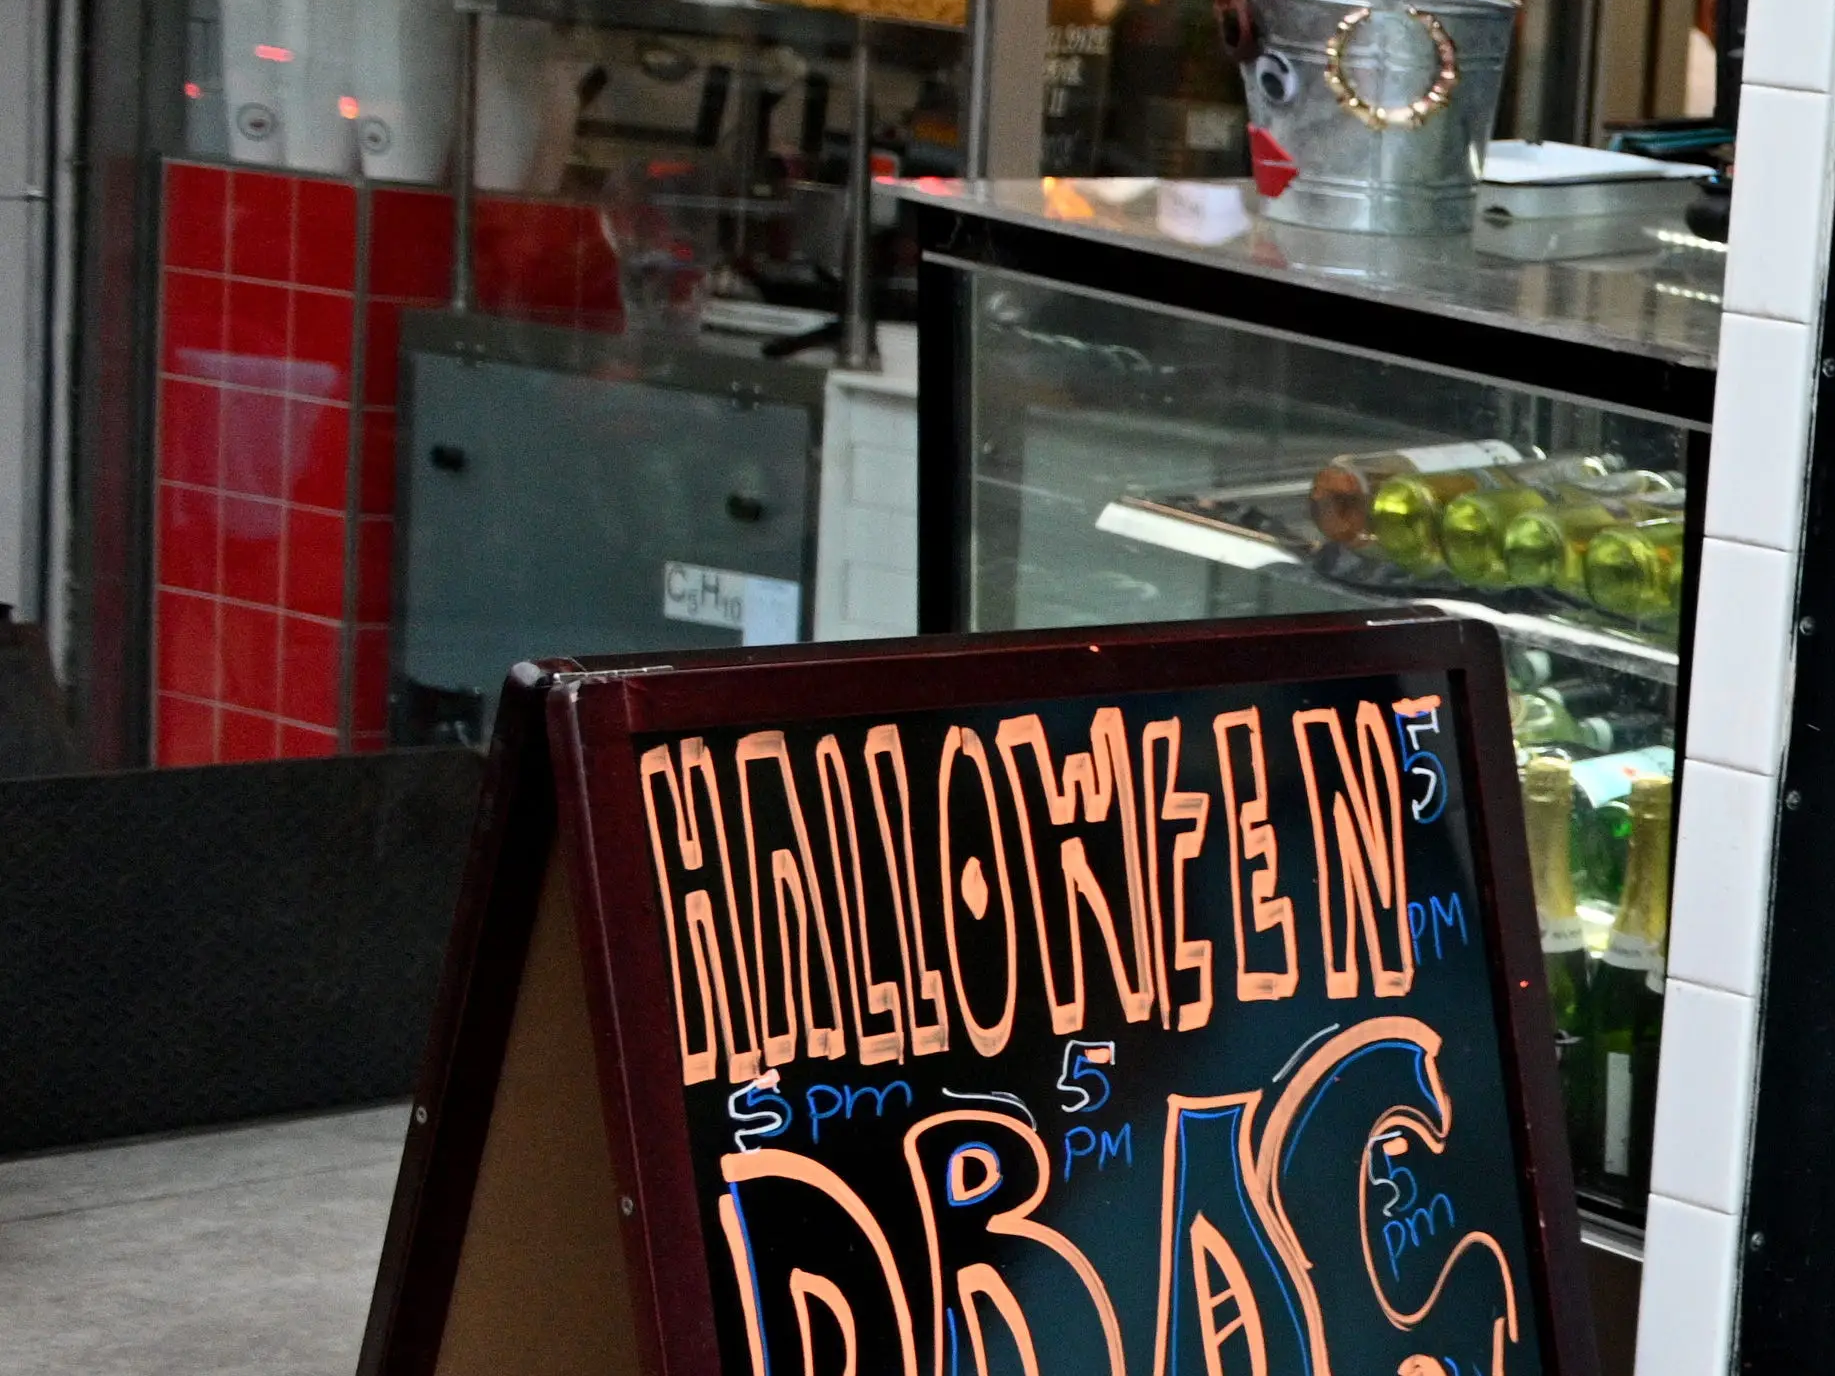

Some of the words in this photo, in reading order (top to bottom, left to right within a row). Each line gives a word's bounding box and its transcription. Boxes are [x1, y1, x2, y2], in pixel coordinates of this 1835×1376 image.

[641, 700, 1414, 1085] HALLOWEEN
[1393, 695, 1449, 826] 5
[1407, 890, 1470, 966] PM
[728, 1069, 793, 1154] 5
[805, 1078, 914, 1145] pm
[1055, 1040, 1117, 1113] 5
[1063, 1125, 1134, 1184] PM
[1367, 1131, 1420, 1219] 5
[1382, 1189, 1456, 1282] pm
